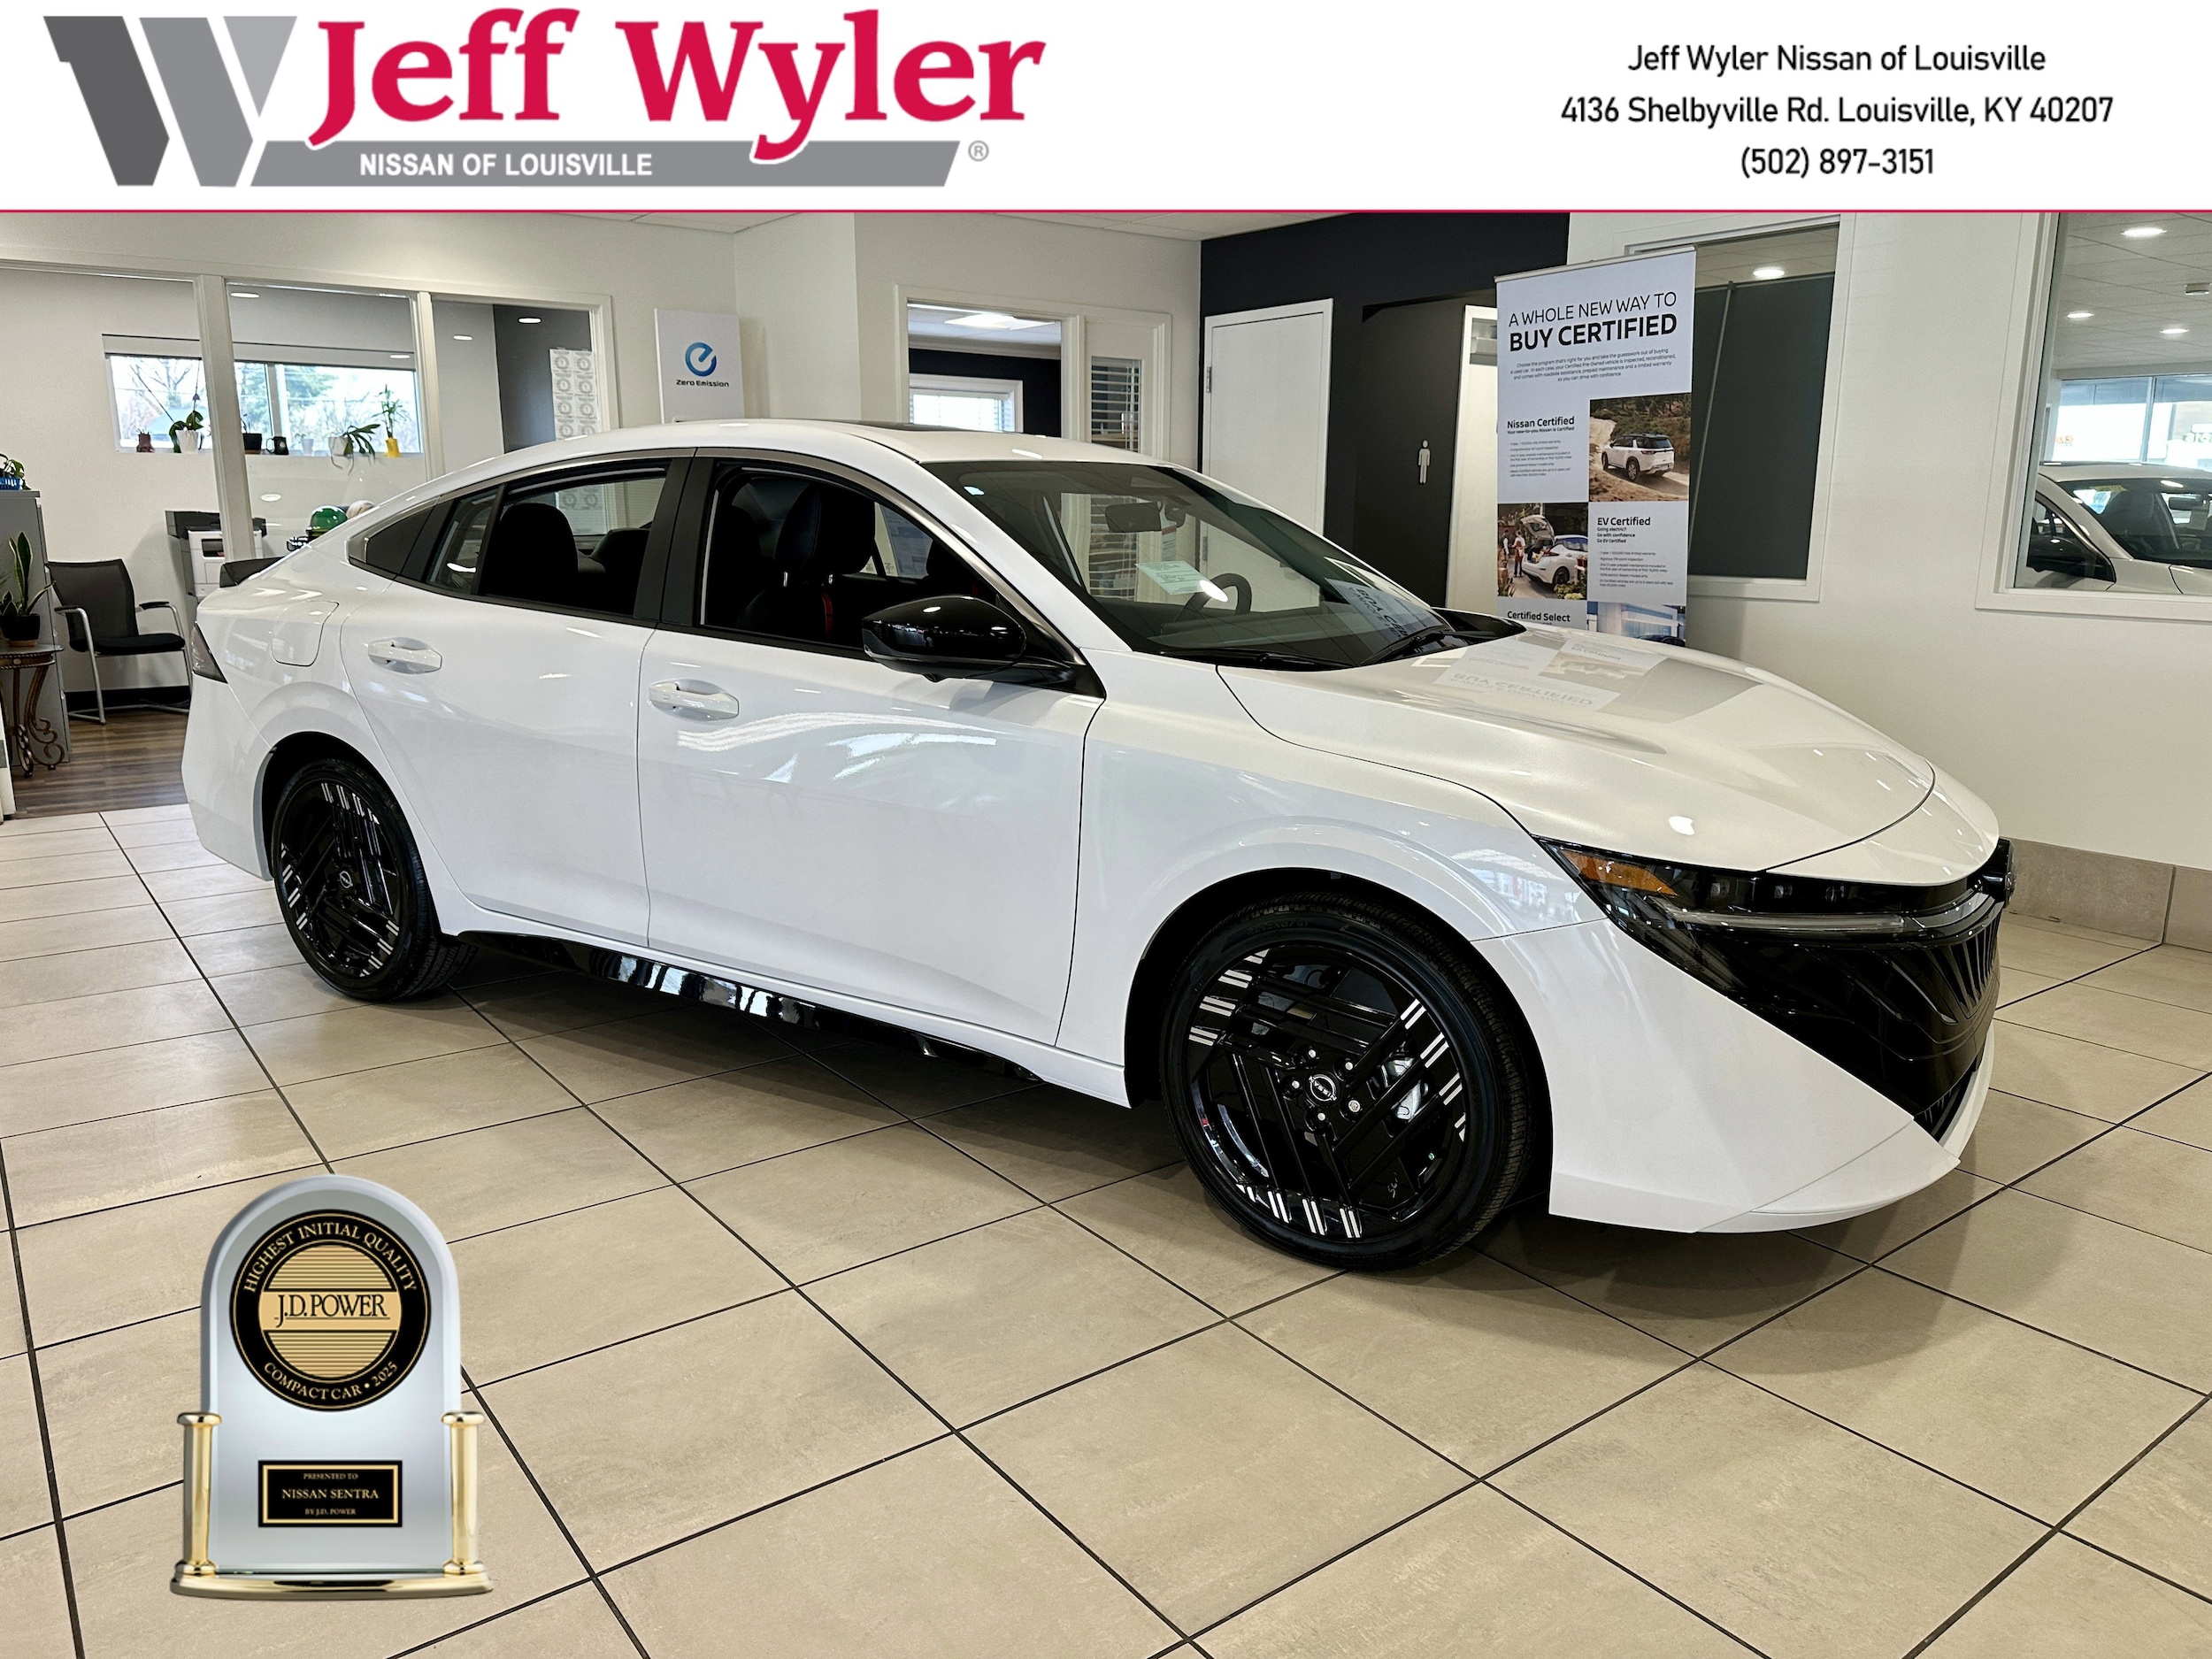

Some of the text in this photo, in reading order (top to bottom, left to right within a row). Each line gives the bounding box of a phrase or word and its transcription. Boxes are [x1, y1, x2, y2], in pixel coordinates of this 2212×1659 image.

[1509, 292, 1677, 327] A WHOLE NEW WAY TO
[1510, 314, 1677, 352] BUY CERTIFIED
[1507, 416, 1574, 429] Nissan Certified
[1611, 517, 1650, 525] Certified
[1507, 611, 1570, 622] Certified Select
